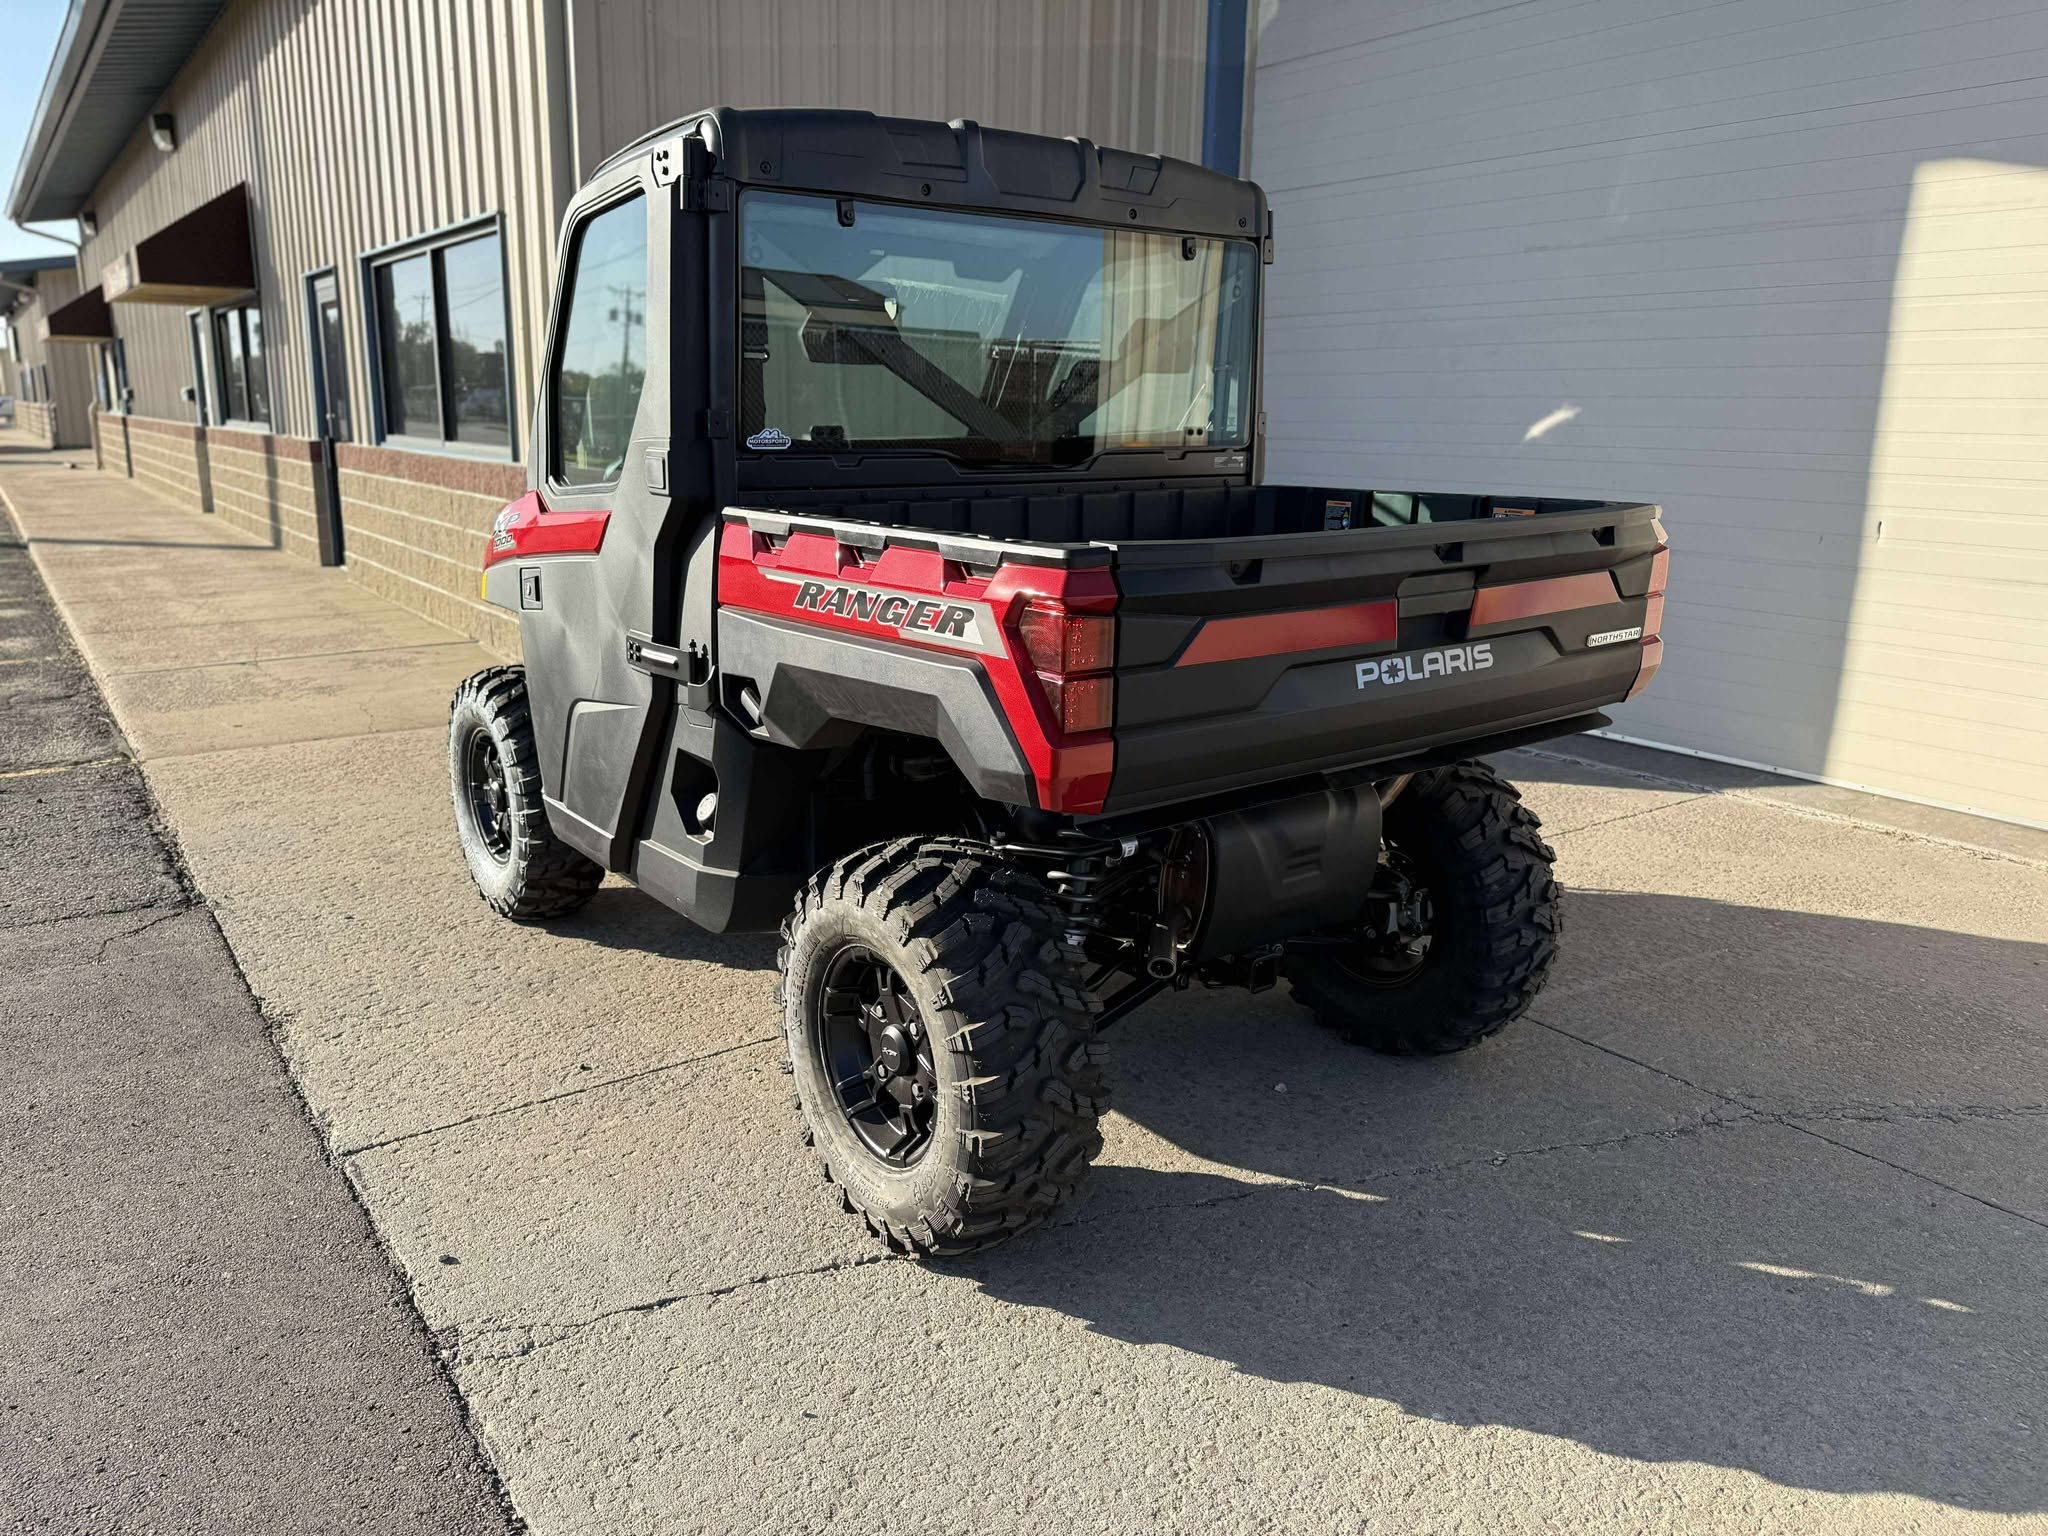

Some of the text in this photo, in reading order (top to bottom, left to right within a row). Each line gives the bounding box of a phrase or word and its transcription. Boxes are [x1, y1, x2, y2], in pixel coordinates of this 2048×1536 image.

[794, 581, 976, 638] RANGER
[1590, 628, 1639, 645] NORTHSTAR
[1355, 643, 1494, 690] POLARIS
[790, 930, 822, 1035] X-TERRAIN
